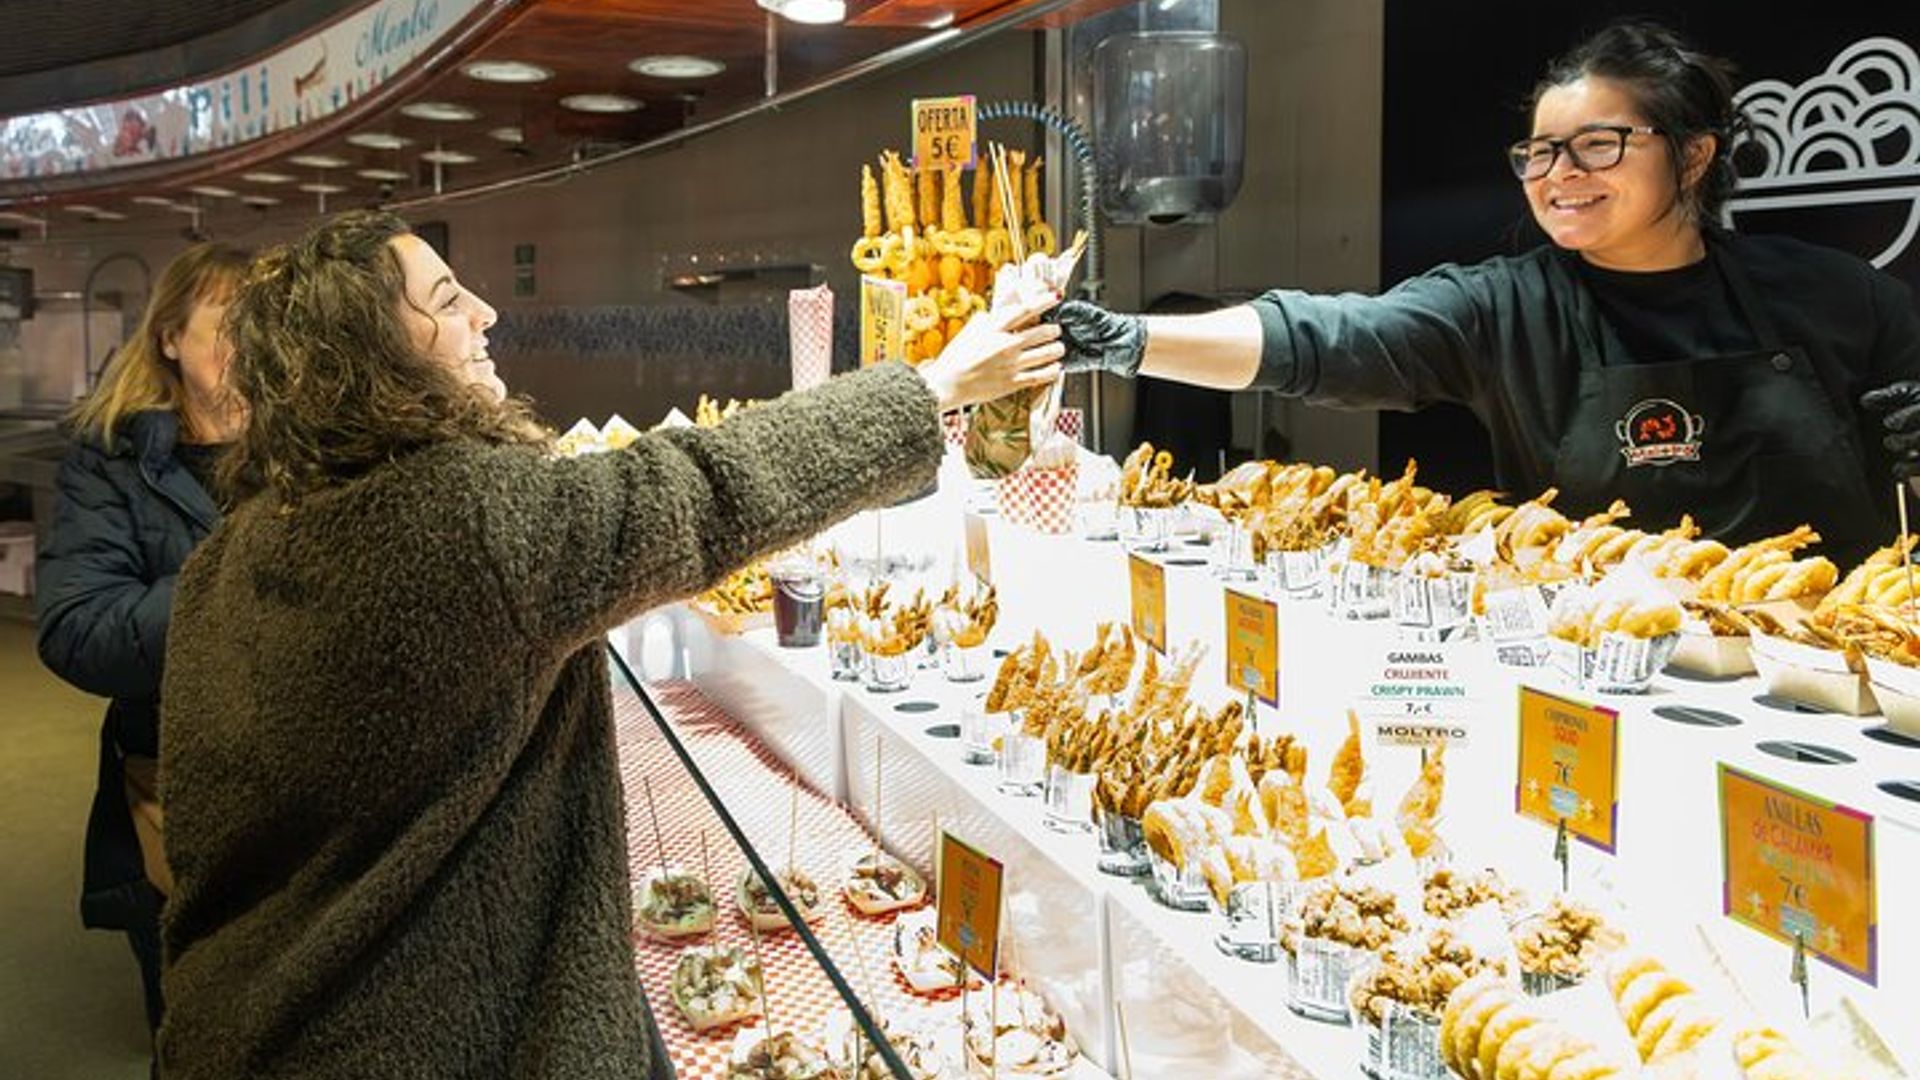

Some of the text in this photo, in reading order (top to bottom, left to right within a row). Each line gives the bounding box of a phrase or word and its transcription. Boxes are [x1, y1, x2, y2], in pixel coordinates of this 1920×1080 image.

[917, 106, 970, 133] OFERTA
[931, 134, 960, 160] 5€
[1387, 652, 1444, 664] GAMBAS
[1371, 684, 1465, 697] CRISPY PRAWN
